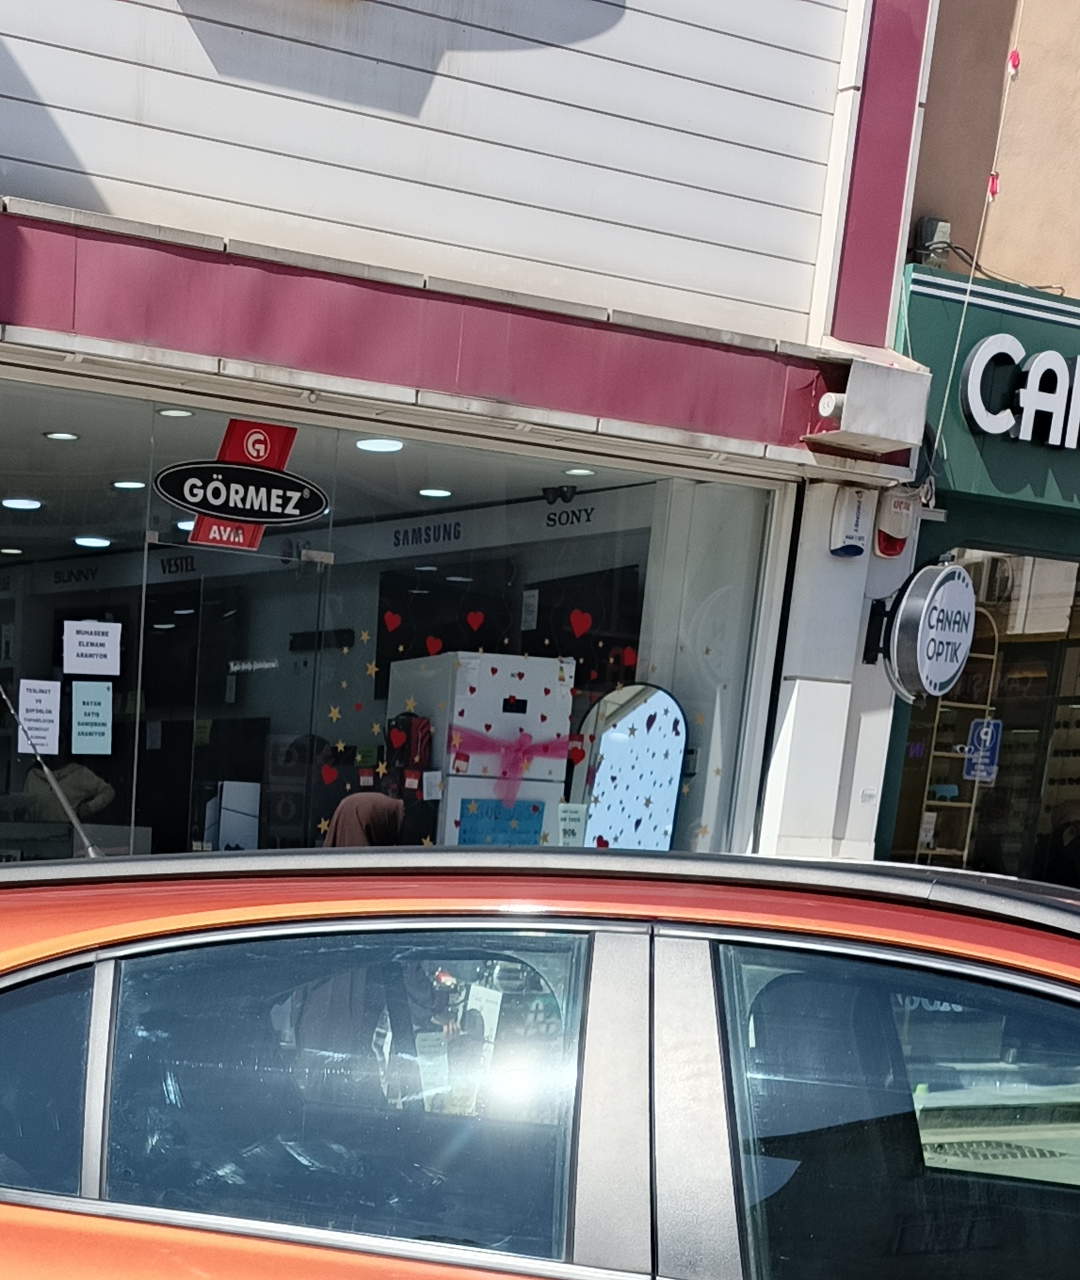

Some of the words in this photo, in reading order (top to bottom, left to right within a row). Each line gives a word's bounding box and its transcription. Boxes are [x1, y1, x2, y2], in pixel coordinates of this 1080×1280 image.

[960, 333, 1080, 449] CA
[183, 474, 302, 515] GÖRMEZ
[546, 508, 595, 527] SONY
[209, 525, 244, 543] AVM
[393, 522, 461, 547] SAMSUNG
[160, 556, 196, 575] VESTEL
[53, 568, 99, 584] SUNNY
[928, 606, 970, 633] CANAN
[75, 629, 109, 638] MUHASEBE
[76, 652, 108, 660] ARANIYOR
[926, 638, 962, 663] OPTIK
